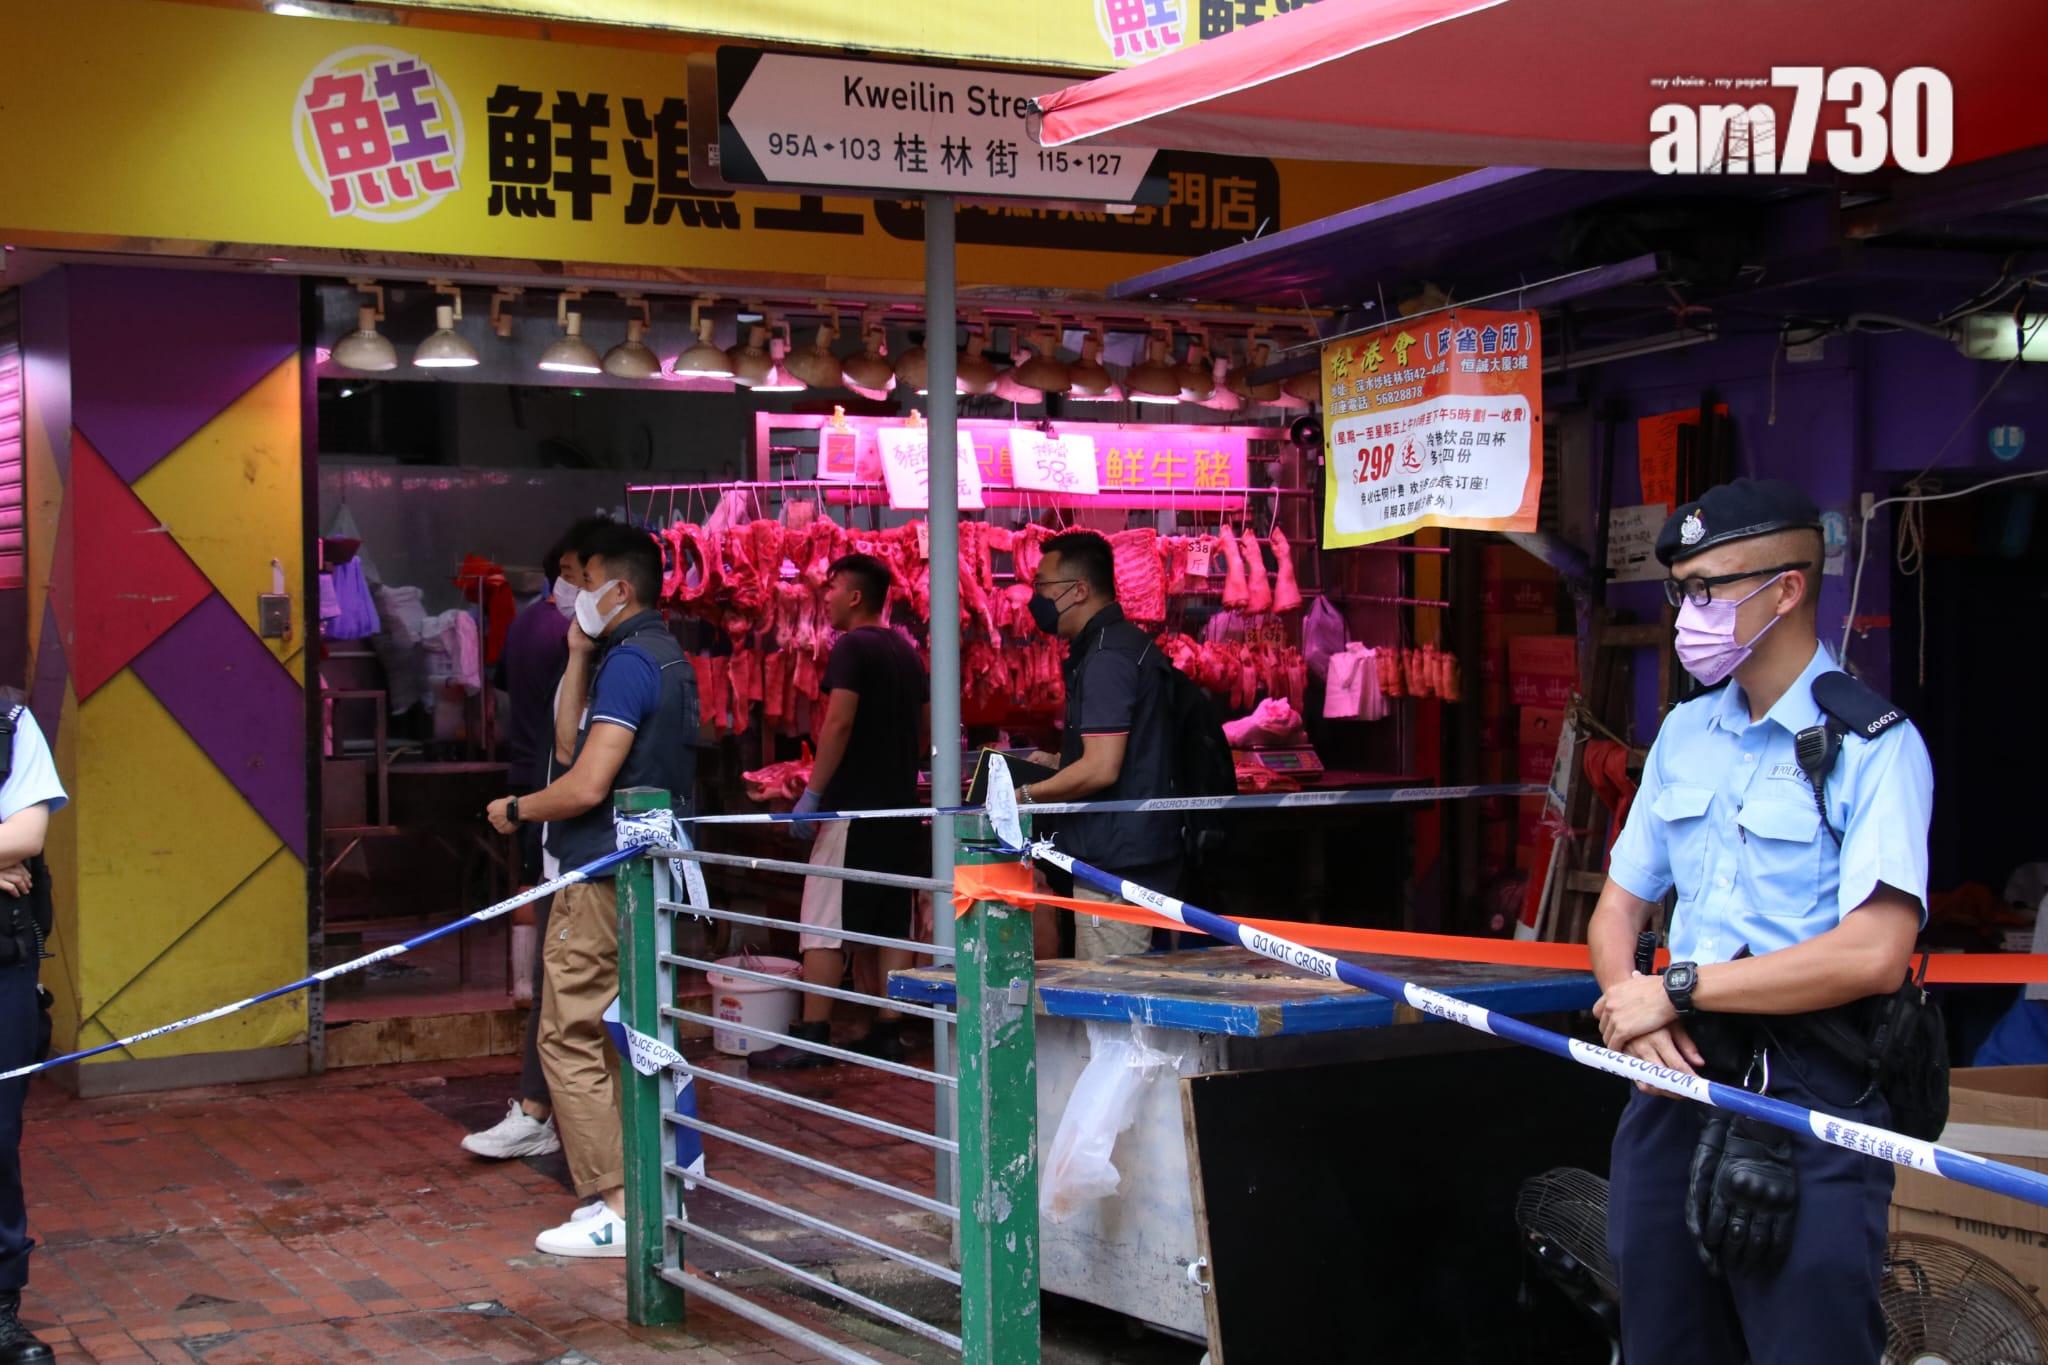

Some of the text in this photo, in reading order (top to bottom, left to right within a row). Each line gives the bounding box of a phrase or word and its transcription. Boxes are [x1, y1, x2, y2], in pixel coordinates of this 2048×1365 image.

[844, 75, 1028, 119] Kweilin Stre
[769, 132, 1122, 178] 95A 103 桂林街 115 127
[1375, 386, 1423, 406] 56828878
[1867, 711, 1899, 733] 60627
[1270, 941, 1293, 961] NOT
[1294, 951, 1332, 977] CROSS
[647, 1060, 660, 1073] NO
